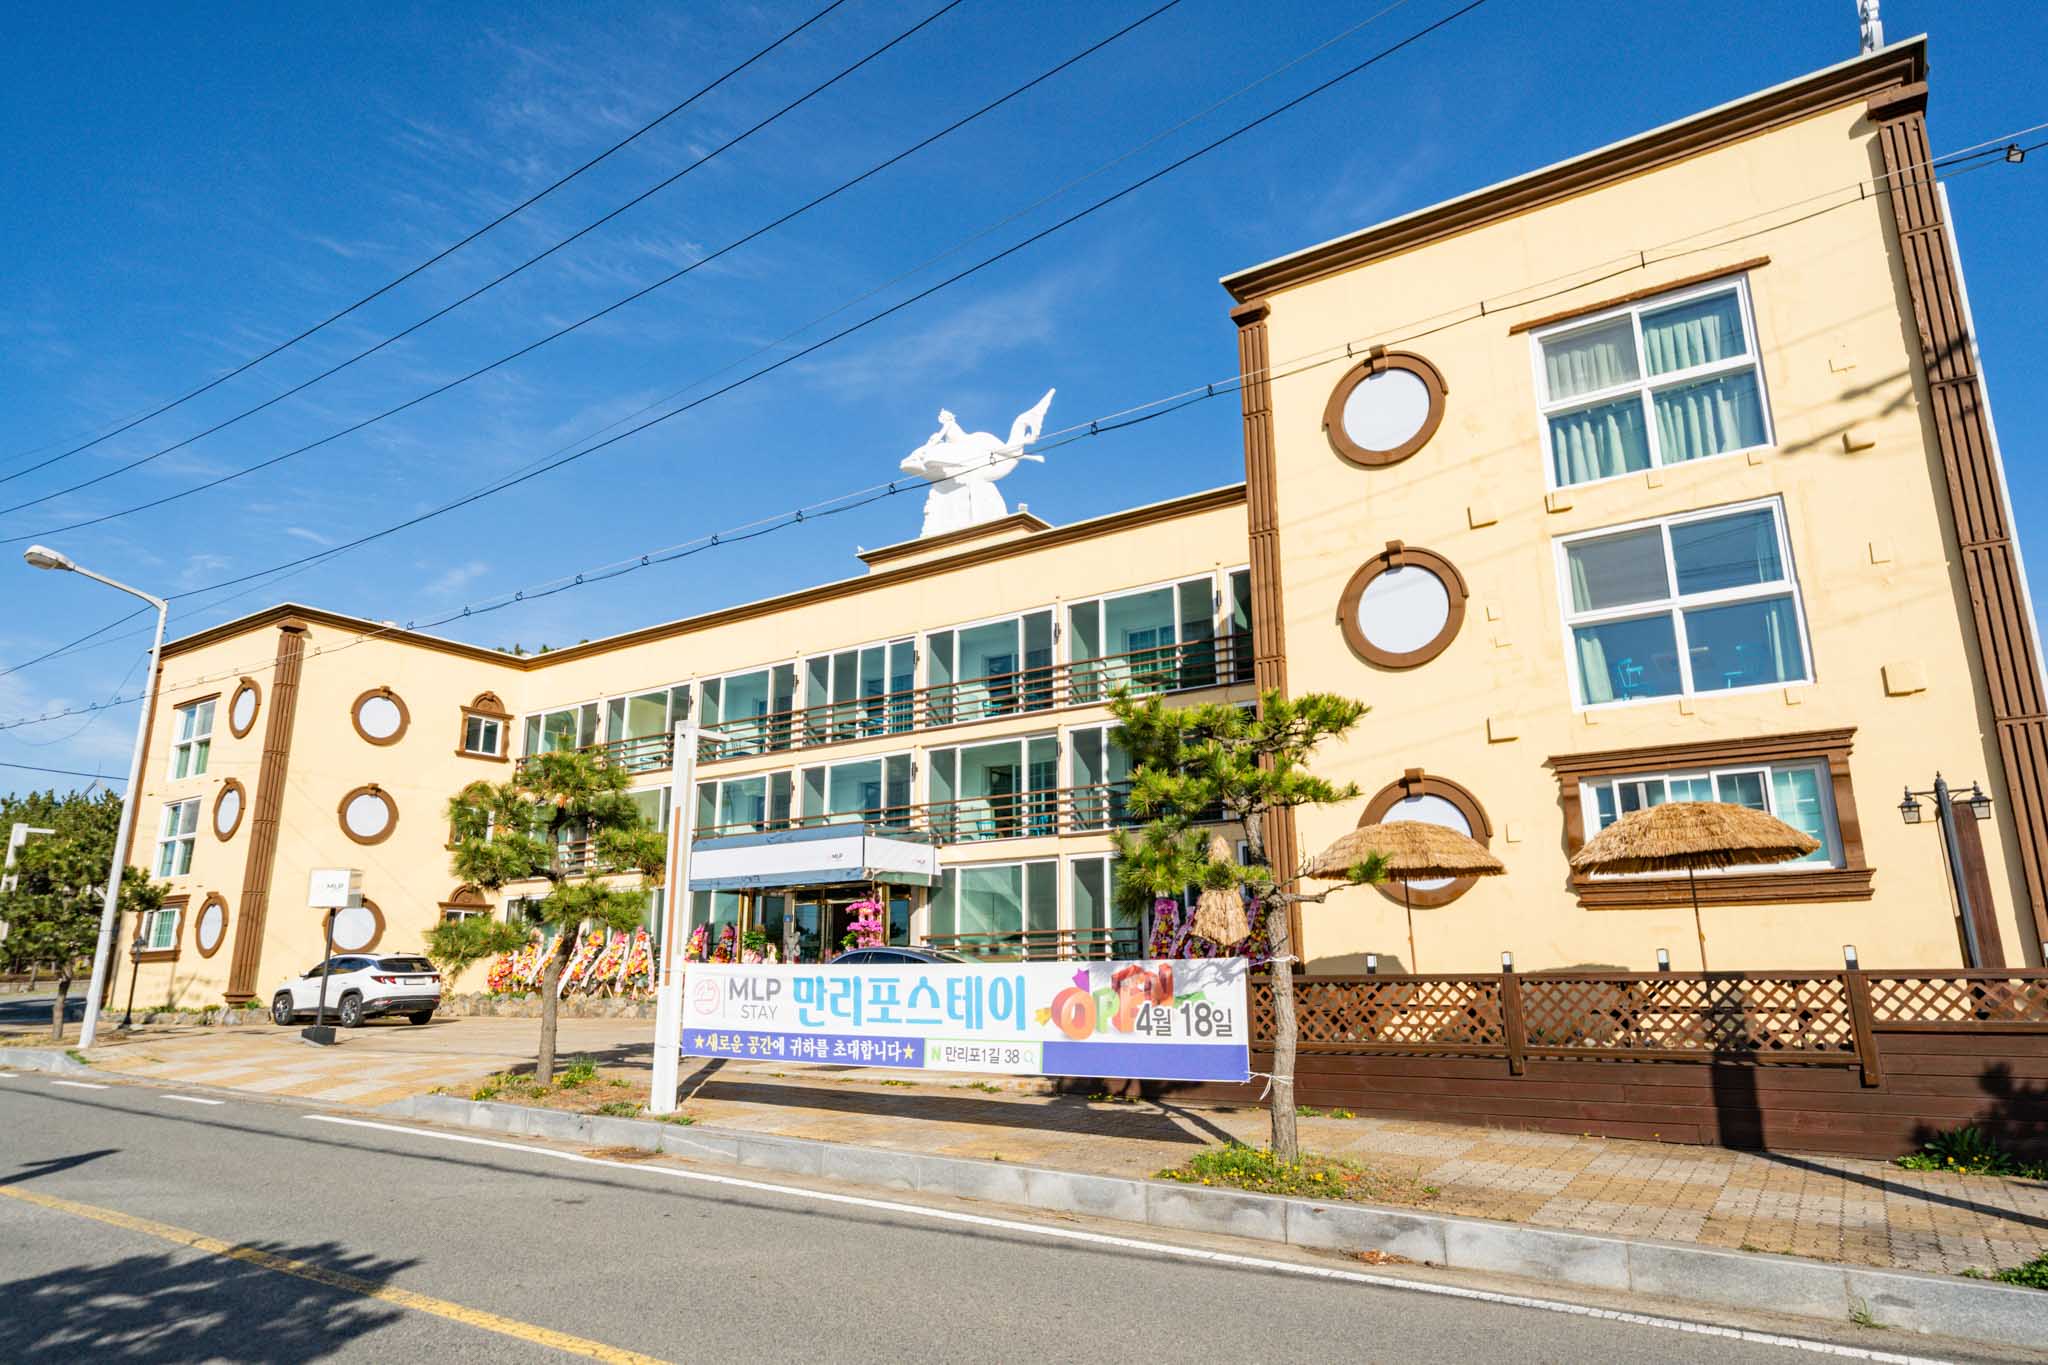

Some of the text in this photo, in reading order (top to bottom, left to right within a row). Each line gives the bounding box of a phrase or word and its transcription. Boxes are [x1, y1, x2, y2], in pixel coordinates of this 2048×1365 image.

[729, 977, 781, 1001] MLP
[741, 1004, 778, 1020] STAY
[793, 975, 1026, 1030] 만리포스테이
[1136, 1002, 1233, 1038] 4월 18일
[706, 1033, 903, 1062] 새로운 공간에 귀하를 초대합니다
[945, 1046, 1020, 1065] 만리포1길 38
